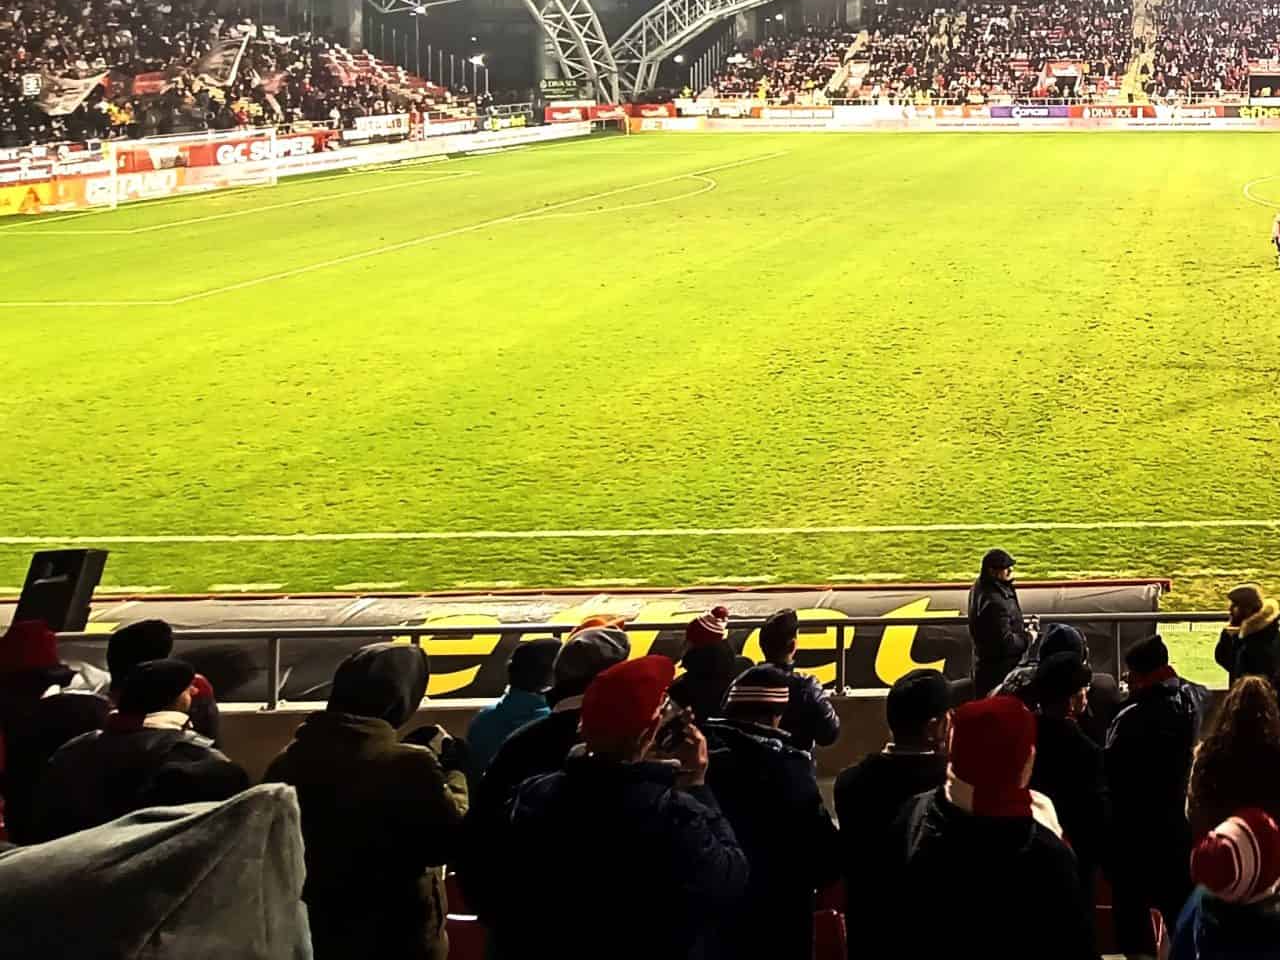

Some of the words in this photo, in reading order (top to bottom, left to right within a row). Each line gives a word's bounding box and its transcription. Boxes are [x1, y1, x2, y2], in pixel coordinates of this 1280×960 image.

[1091, 108, 1113, 117] DIVA
[216, 143, 248, 165] GC
[249, 136, 315, 161] SUPER
